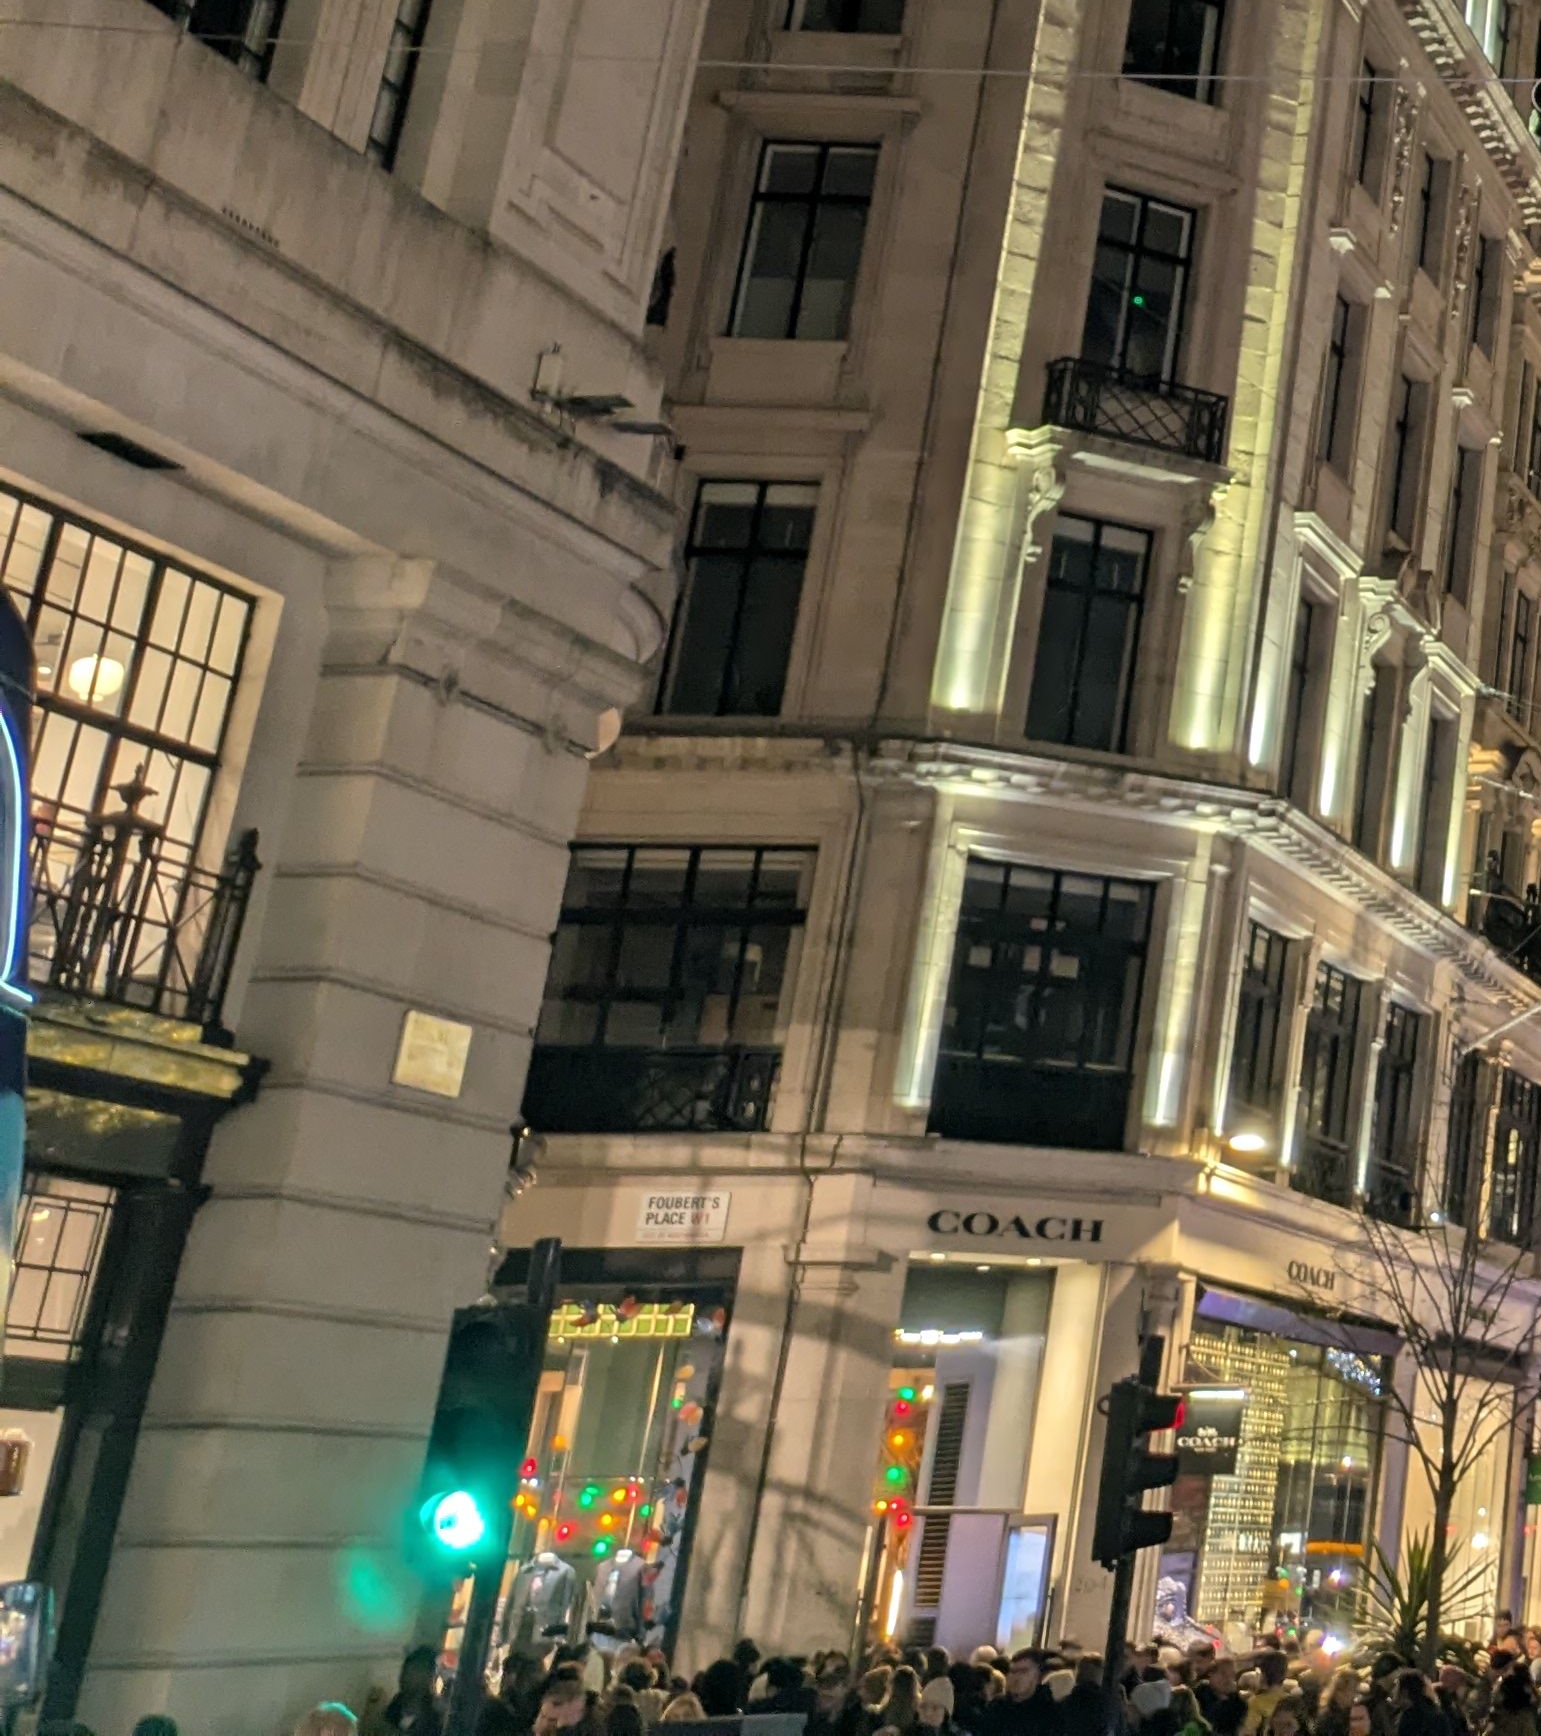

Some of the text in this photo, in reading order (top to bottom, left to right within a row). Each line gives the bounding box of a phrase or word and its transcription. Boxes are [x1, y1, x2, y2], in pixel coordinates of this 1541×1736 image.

[647, 1195, 721, 1210] FOUBERT'S
[645, 1212, 710, 1225] PLACE W1
[927, 1209, 1105, 1242] COACH
[1288, 1260, 1336, 1291] COACH
[1177, 1436, 1236, 1448] COACH
